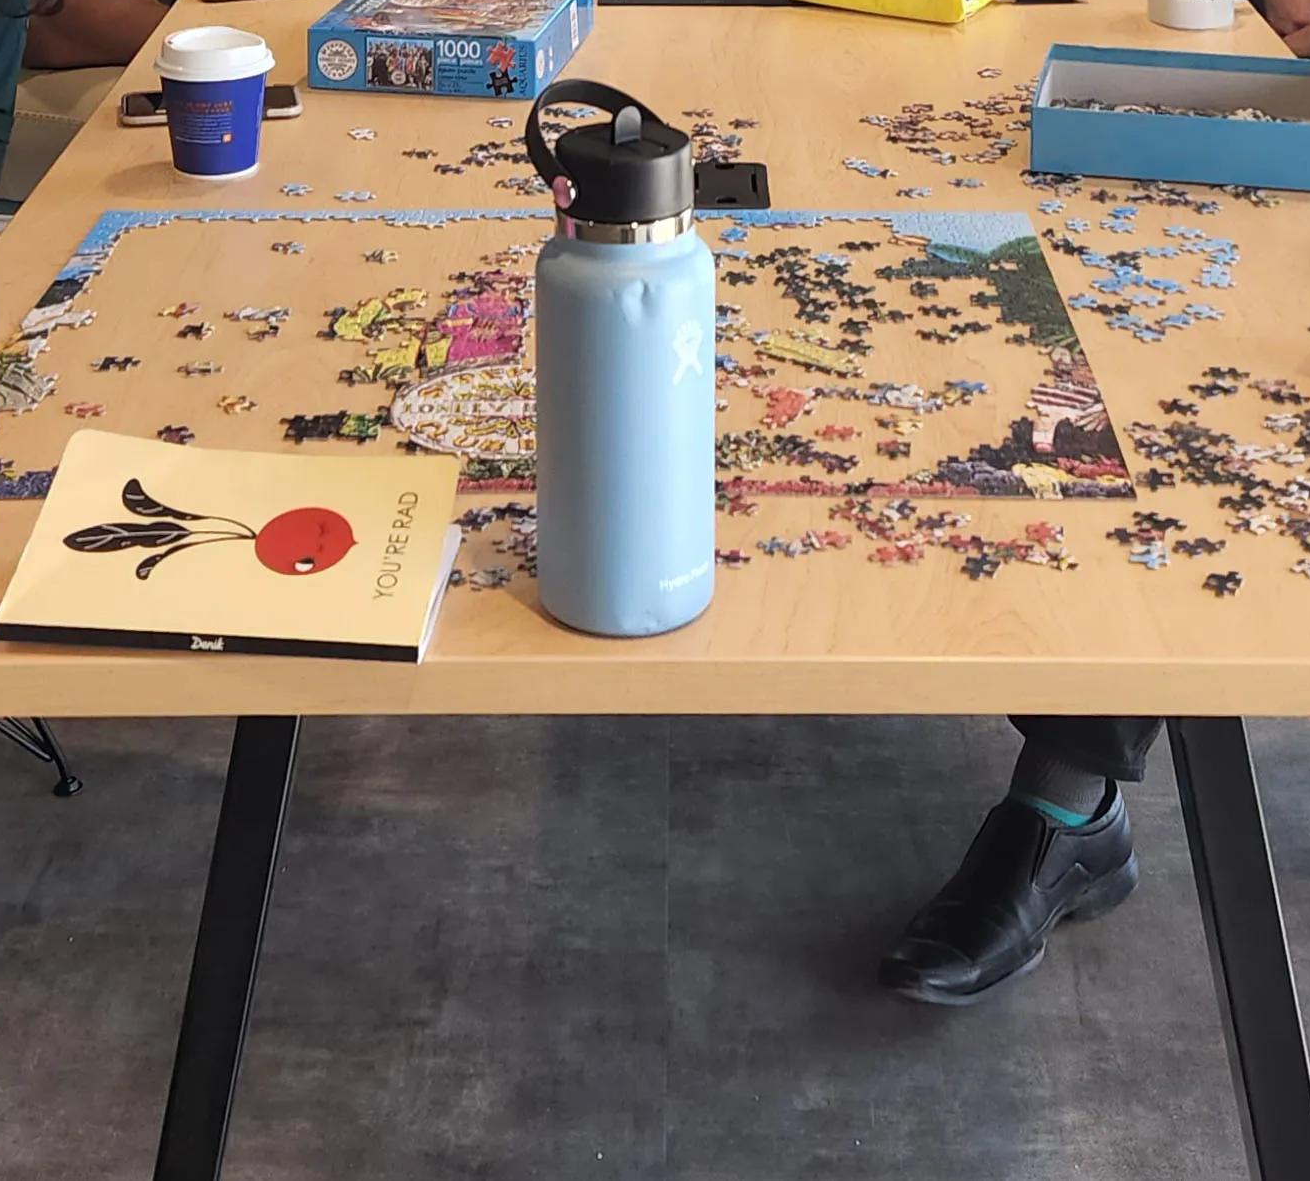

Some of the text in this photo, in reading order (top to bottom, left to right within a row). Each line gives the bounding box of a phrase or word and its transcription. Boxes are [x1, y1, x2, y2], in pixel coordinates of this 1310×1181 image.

[436, 39, 481, 59] 1000
[519, 45, 528, 96] AQUARIUS
[373, 491, 419, 600] YOU'RE RAD
